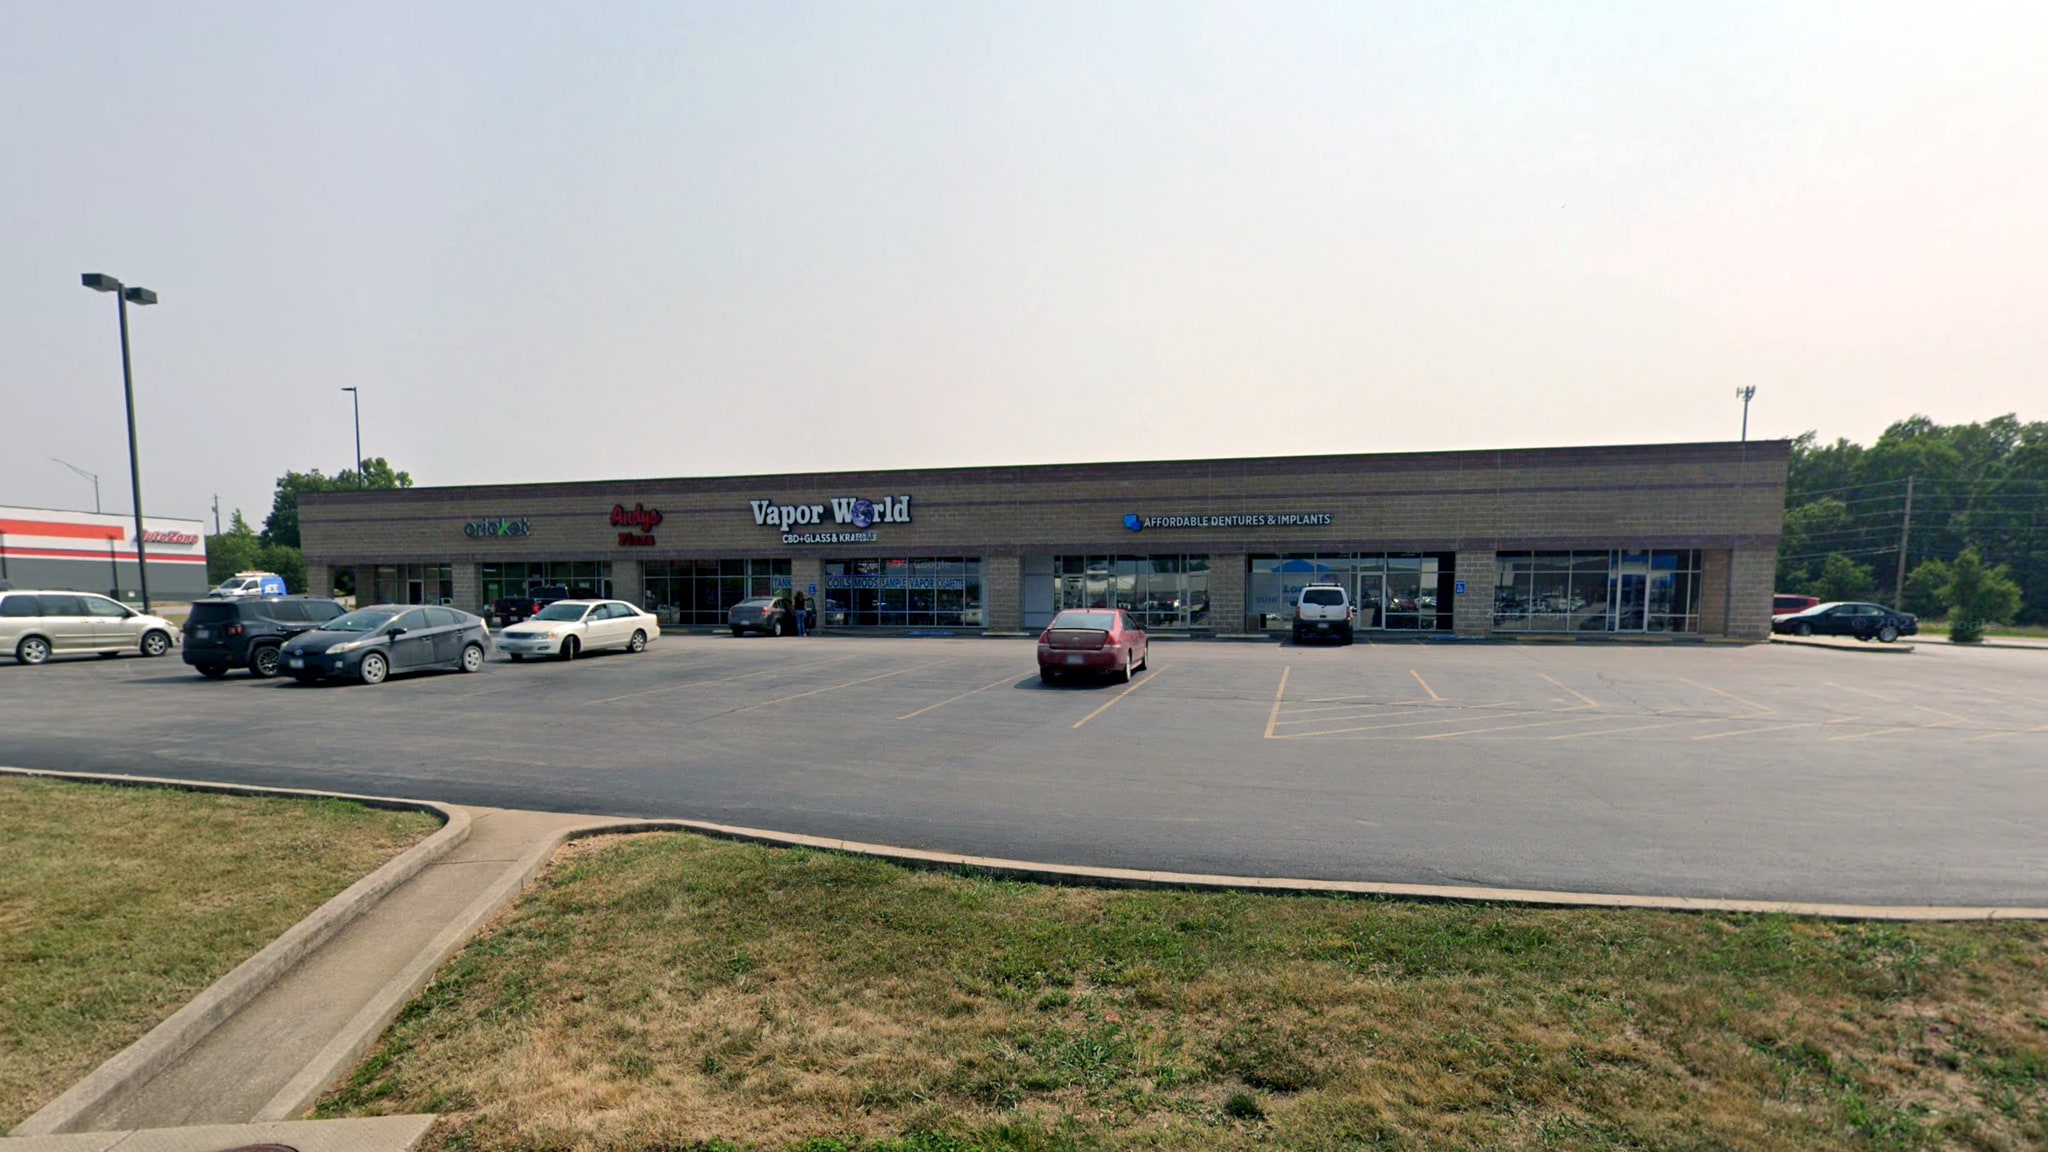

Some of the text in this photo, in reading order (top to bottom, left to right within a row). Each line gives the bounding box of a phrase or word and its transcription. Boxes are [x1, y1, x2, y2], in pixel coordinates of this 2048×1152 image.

[750, 495, 910, 531] Vapor World
[1144, 513, 1331, 528] AFFORDABLE DENTURES & IMPLANTS
[831, 533, 838, 543] &
[839, 532, 877, 543] KRA
[827, 577, 850, 588] COILS
[854, 577, 878, 588] MODS
[881, 577, 907, 588] SAMPLE
[910, 577, 934, 588] VAPOR
